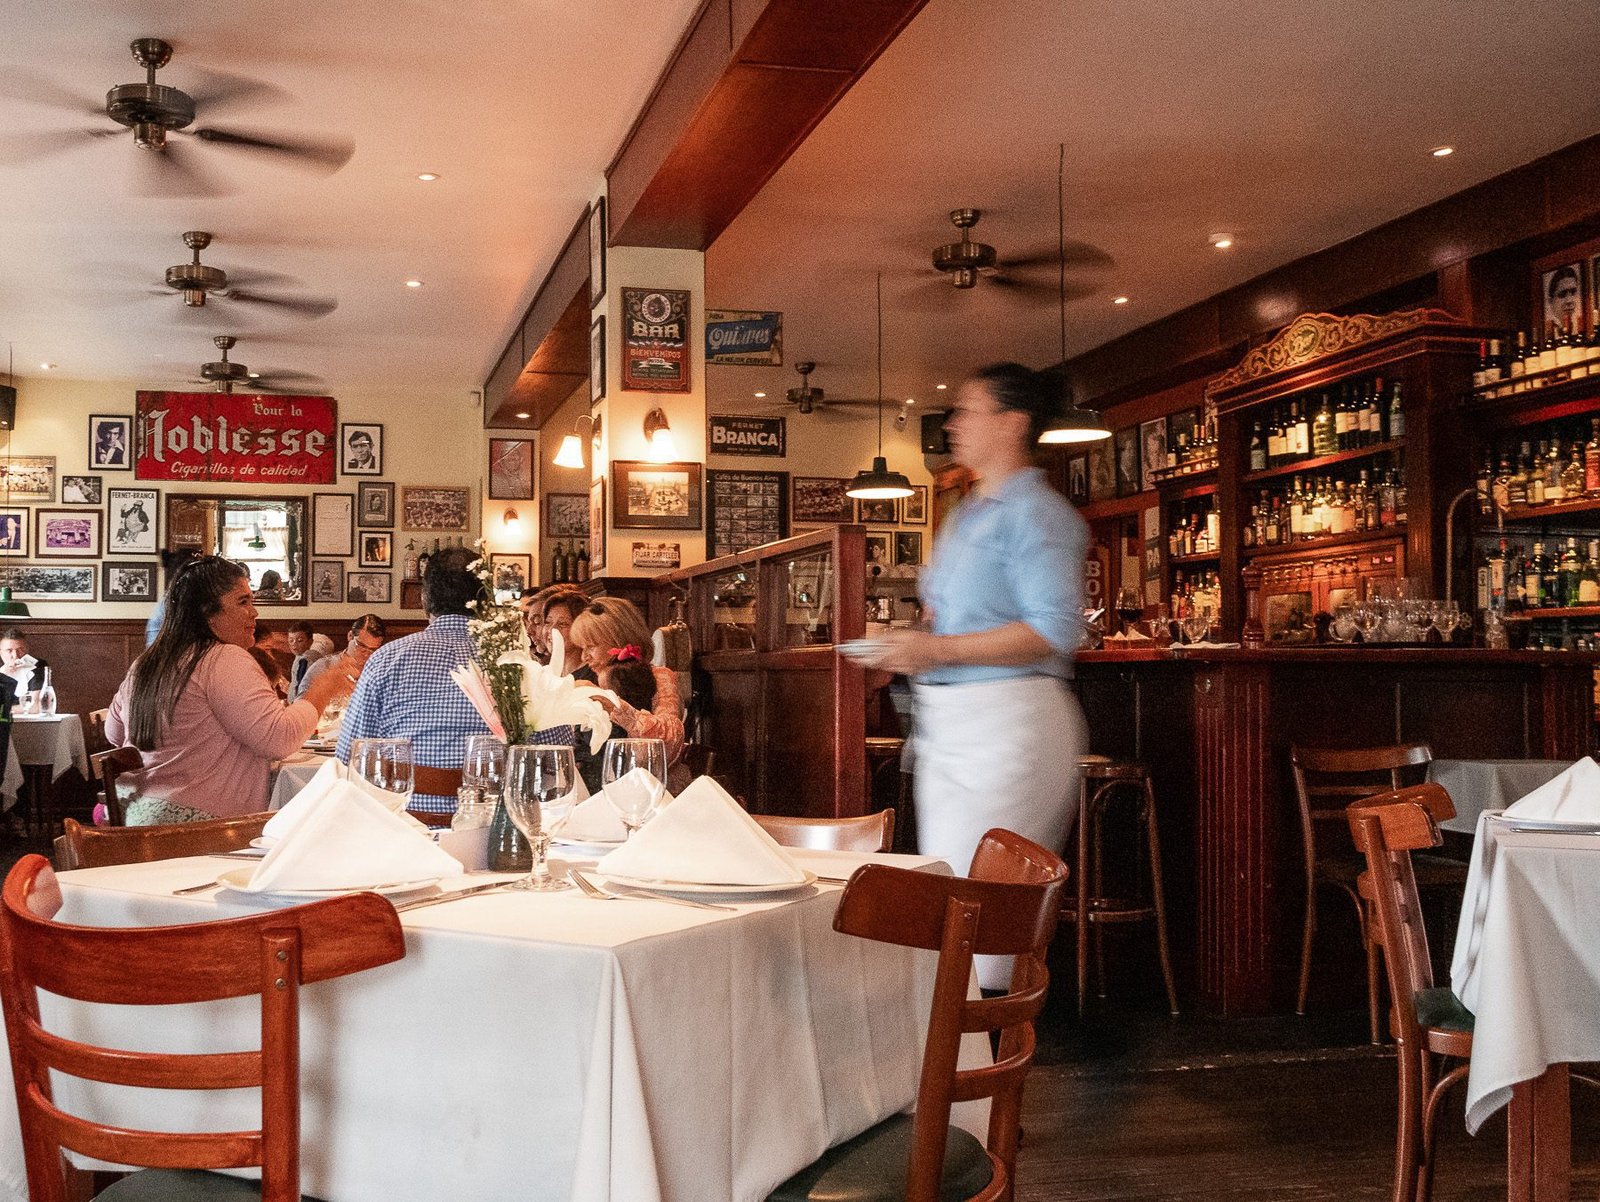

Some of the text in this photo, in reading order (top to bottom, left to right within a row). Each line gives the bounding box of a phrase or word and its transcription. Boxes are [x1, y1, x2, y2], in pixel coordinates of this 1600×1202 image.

[631, 320, 681, 338] BAR
[253, 403, 303, 417] Pour la
[732, 421, 764, 430] FERNET
[137, 408, 327, 463] Noblesse
[712, 425, 778, 447] BRANCA
[171, 461, 308, 479] Cigarrillos de calidad
[111, 491, 155, 500] FERNET-BRANCA
